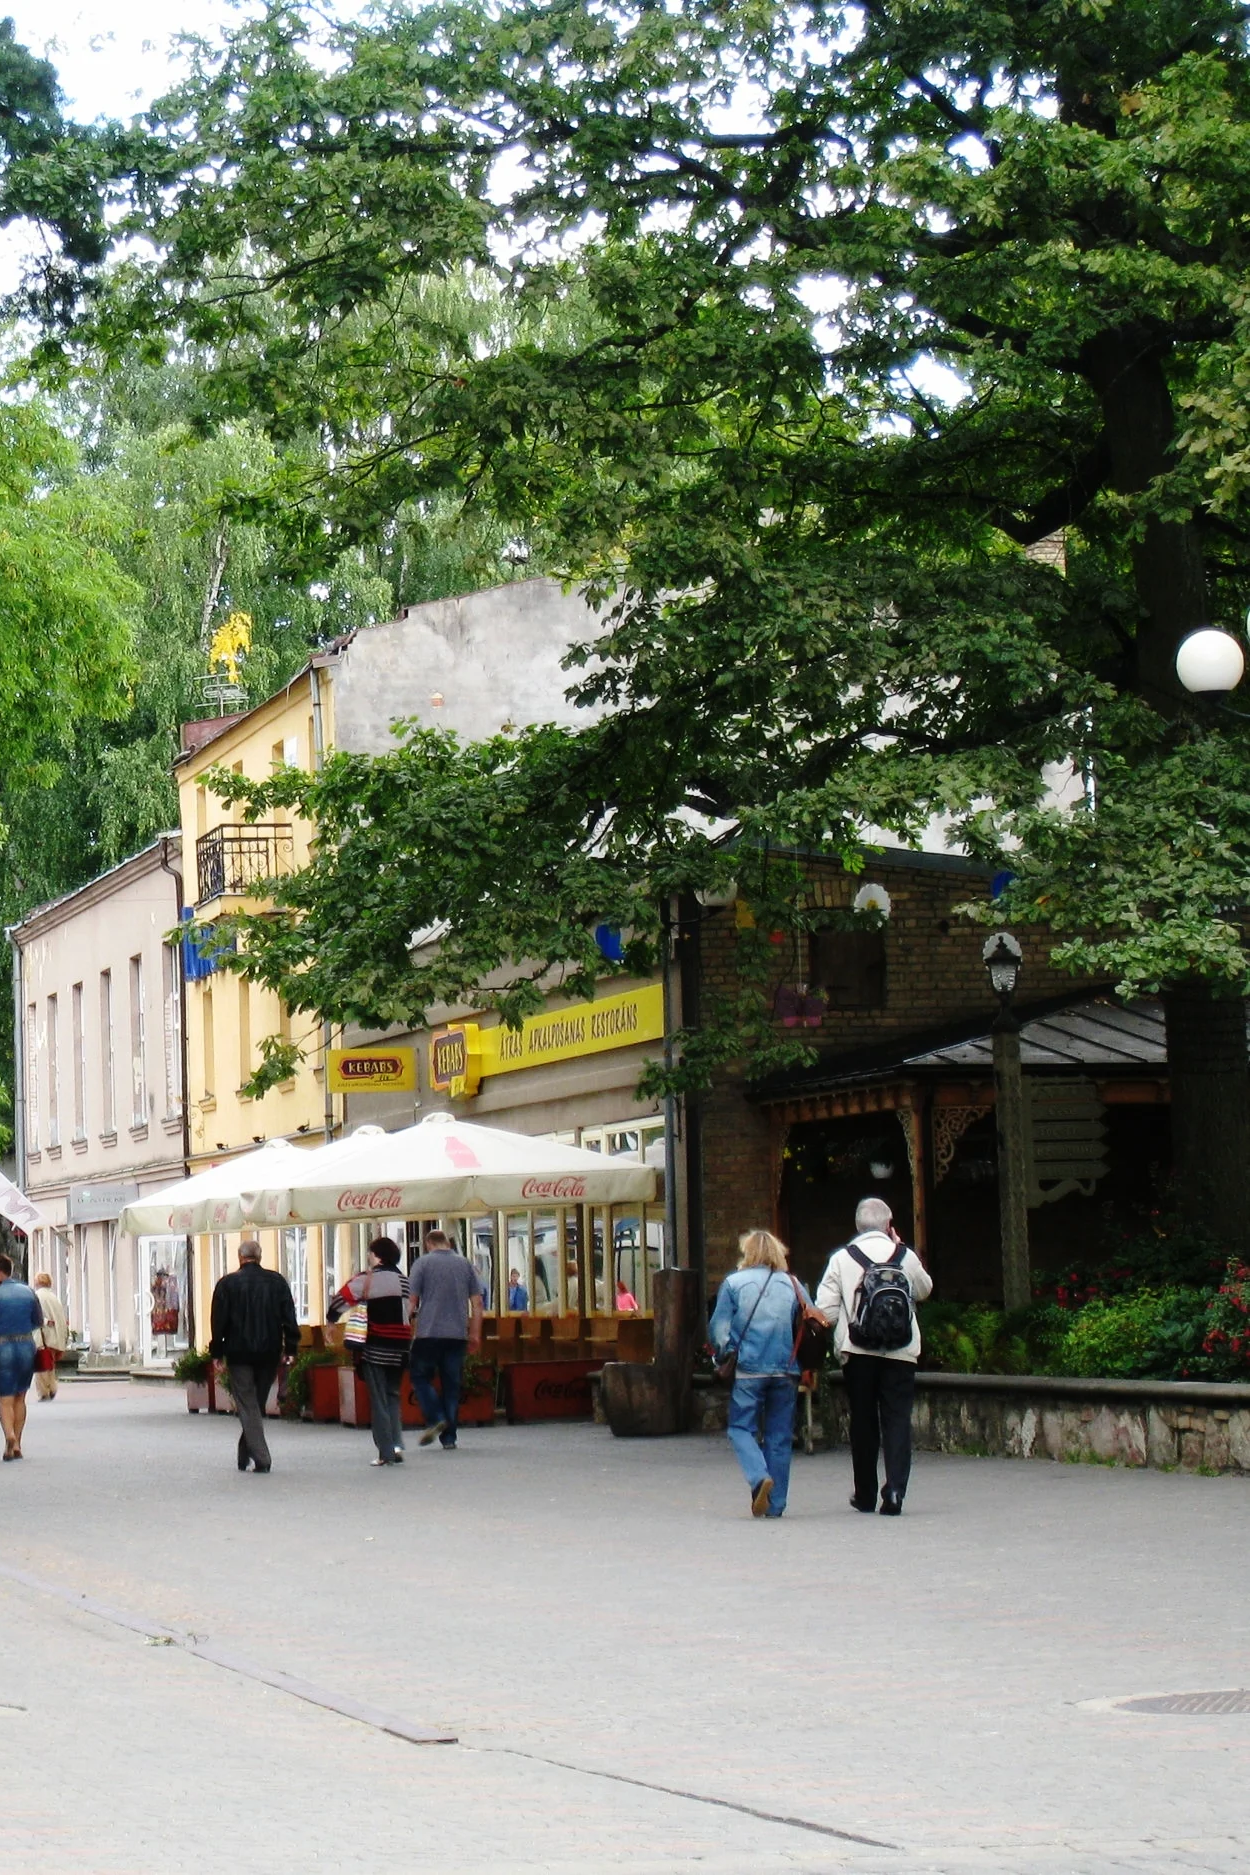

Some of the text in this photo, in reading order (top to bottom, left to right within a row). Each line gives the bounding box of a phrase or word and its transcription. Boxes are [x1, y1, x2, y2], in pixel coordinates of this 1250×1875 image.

[591, 1000, 638, 1040] RESTORĀNS
[348, 1060, 394, 1074] KEBABS
[437, 1040, 464, 1075] KEBABS
[337, 1185, 405, 1212] Coca-Cola
[520, 1175, 587, 1199] Coca-Cola
